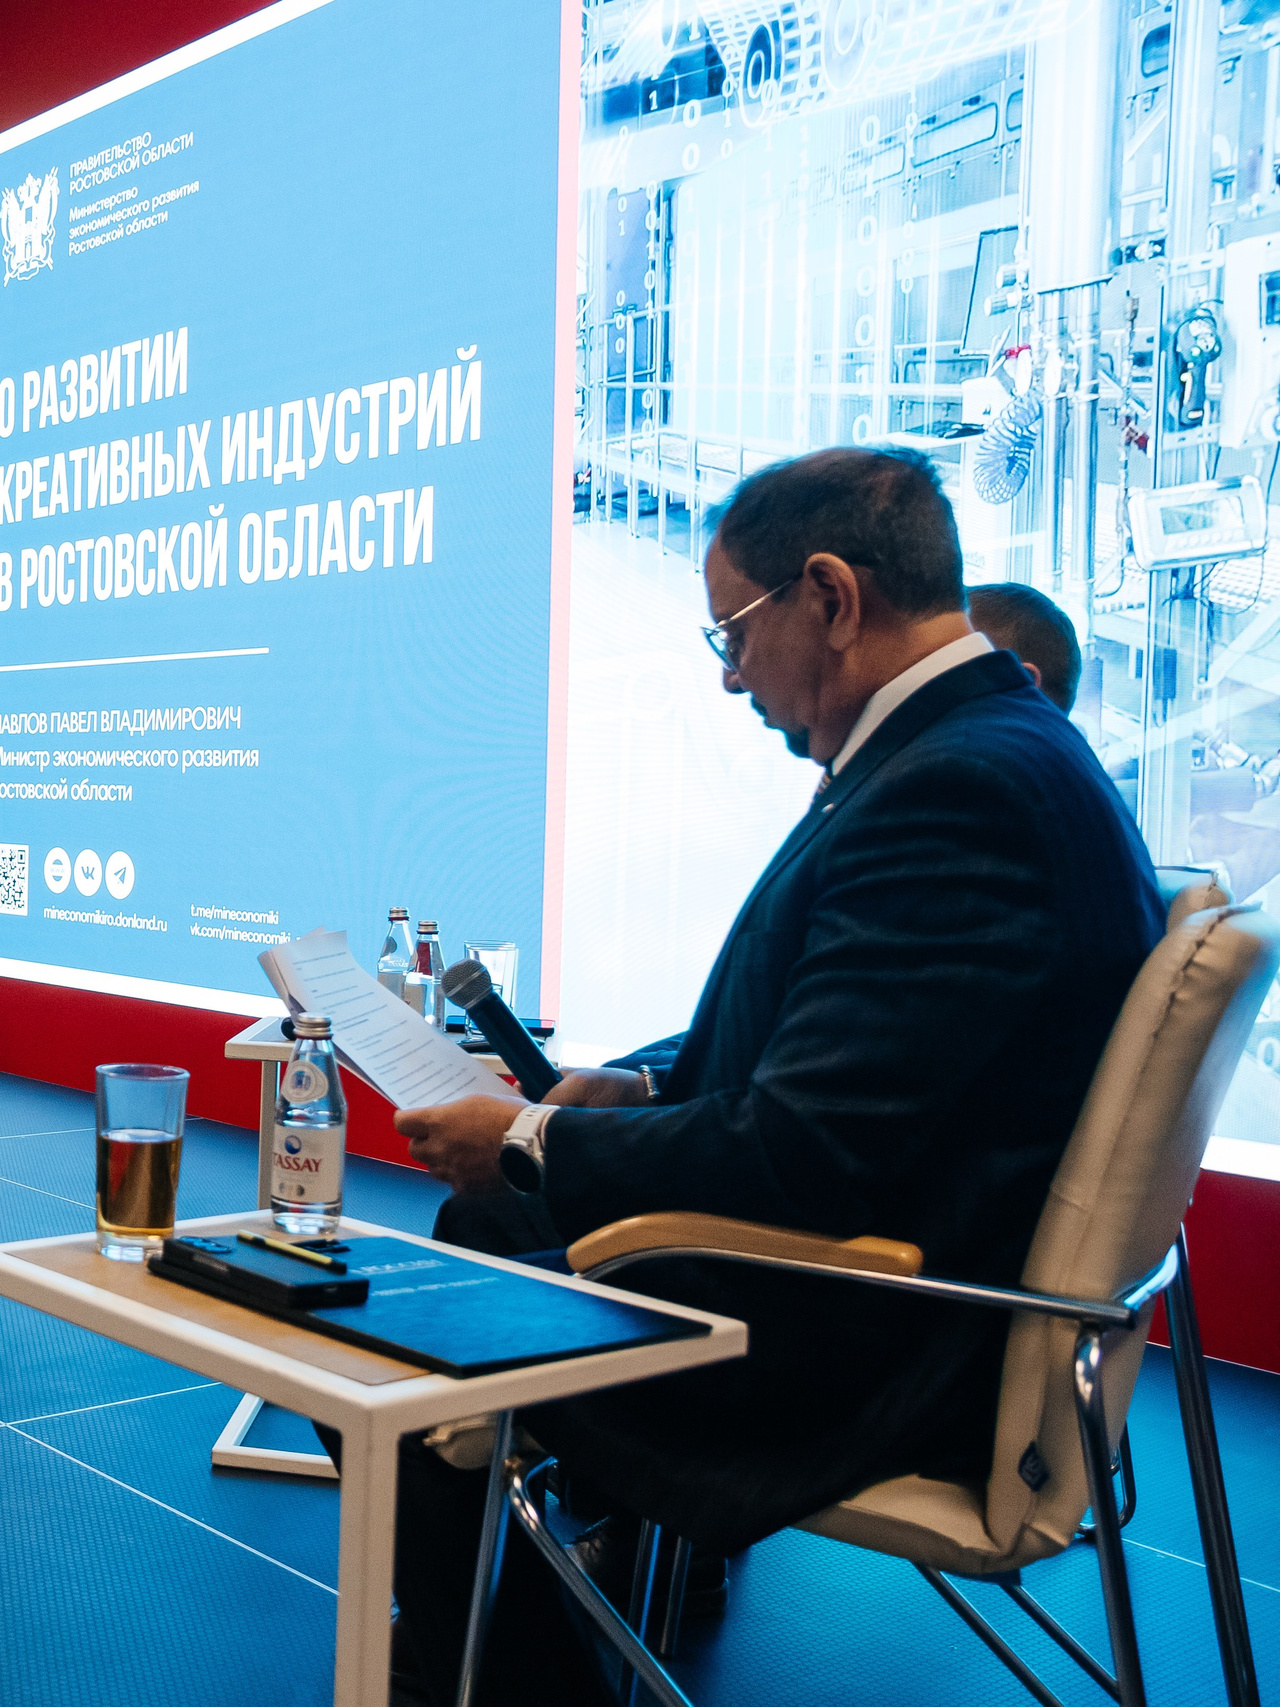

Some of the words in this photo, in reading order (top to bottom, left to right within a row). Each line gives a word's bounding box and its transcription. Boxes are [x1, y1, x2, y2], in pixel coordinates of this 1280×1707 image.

[70, 131, 152, 178] ПРАВИТЕЛЬСТВО
[70, 152, 140, 195] РОСТОВСКОЙ
[142, 132, 194, 165] ОБЛАСТИ
[69, 199, 150, 240] экономического
[152, 180, 199, 209] развития
[70, 186, 139, 222] Министерство
[69, 225, 124, 257] Ростовской
[126, 210, 168, 235] области
[22, 326, 189, 433] РАЗВИТИИ
[220, 344, 483, 486] ИНДУСТРИЙ
[20, 502, 228, 610] РОСТОВСКОЙ
[238, 485, 435, 585] ОБЛАСТИ
[50, 710, 98, 734] ПАВЕЛ
[100, 705, 242, 737] ВЛАДИМИРОВИЧ
[52, 747, 180, 769] экономического
[181, 748, 260, 775] развития
[71, 778, 133, 802] области
[43, 905, 168, 933] mineconomikiro.donland.ru
[190, 904, 279, 925] t.me/mineconomiki
